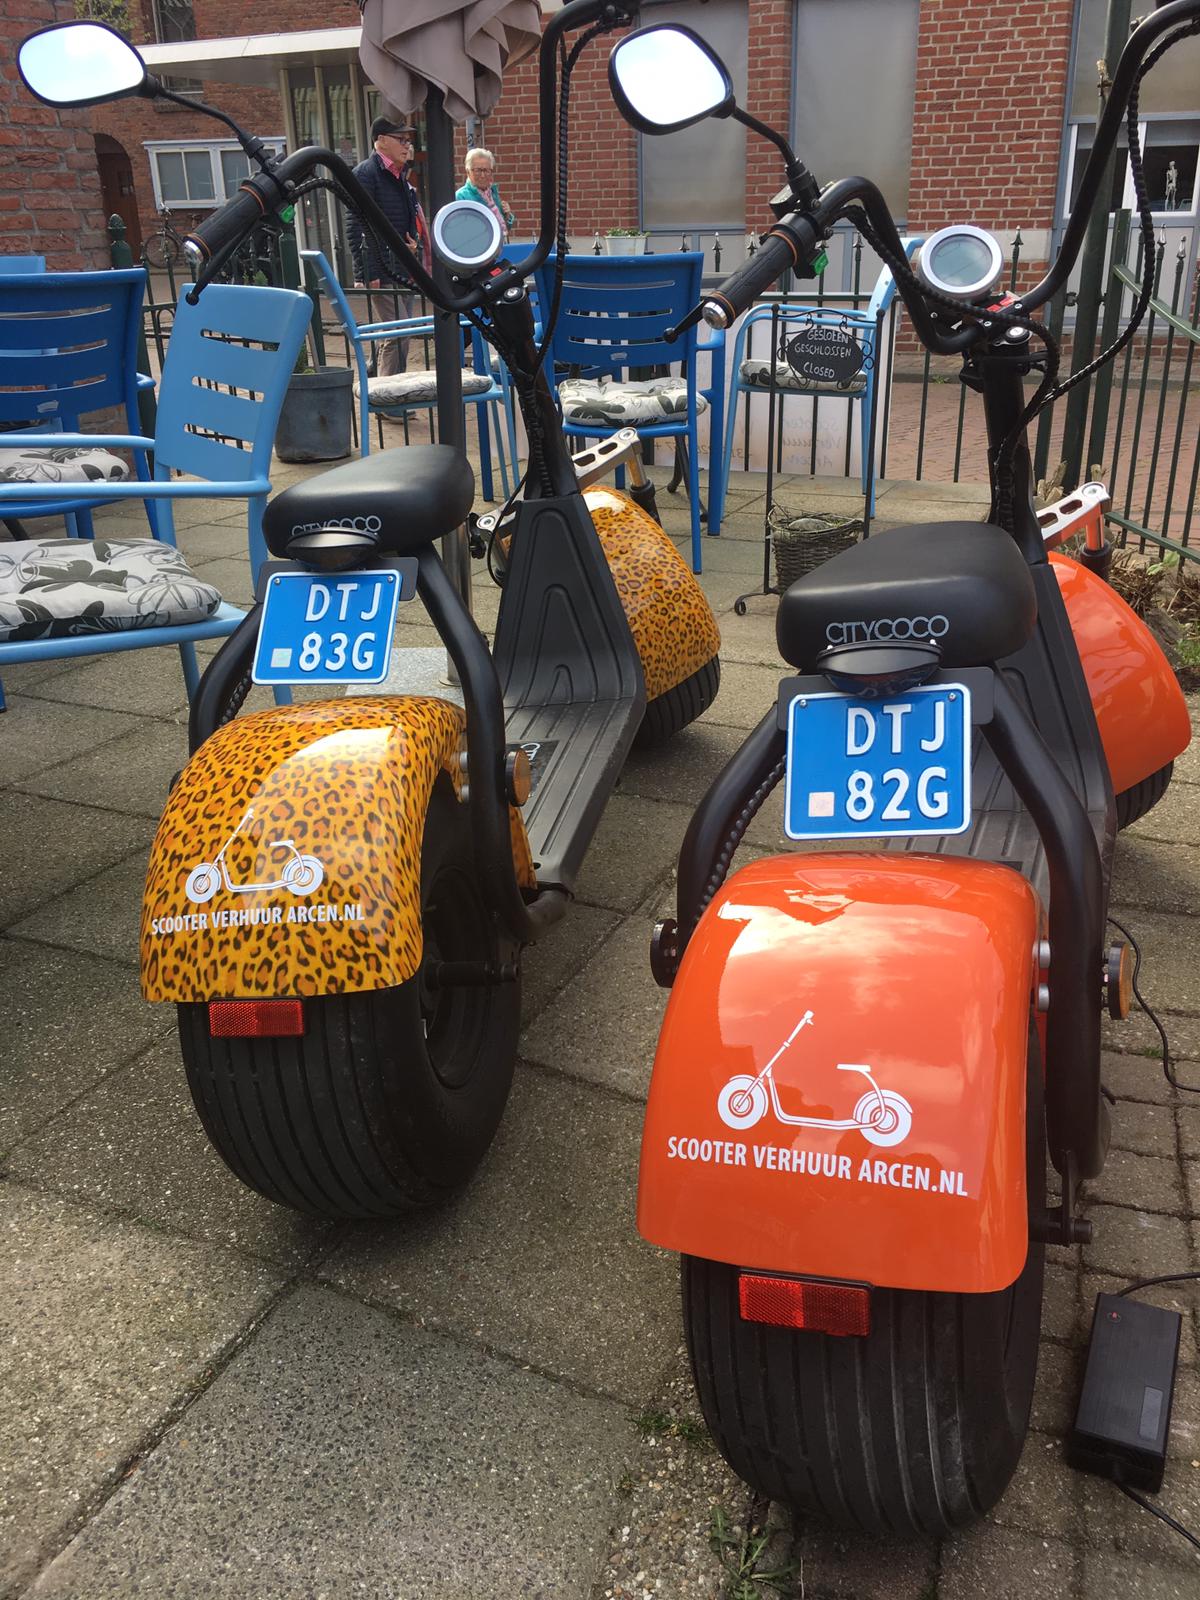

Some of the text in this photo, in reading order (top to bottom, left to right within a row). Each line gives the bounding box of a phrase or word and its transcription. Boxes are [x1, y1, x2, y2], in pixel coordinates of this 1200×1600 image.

[794, 342, 851, 358] GESCHLOSSEN
[803, 361, 835, 379] CLOSED
[305, 583, 382, 622] DTJ
[826, 614, 950, 643] CITYCOCO
[299, 631, 377, 672] 83G
[846, 701, 946, 756] DTJ
[845, 766, 950, 821] 82G
[151, 904, 365, 935] SCOOTER VERHUUR ARCEN.NL
[667, 1136, 968, 1197] SCOOTER VERHUUR ARCEN.NL
